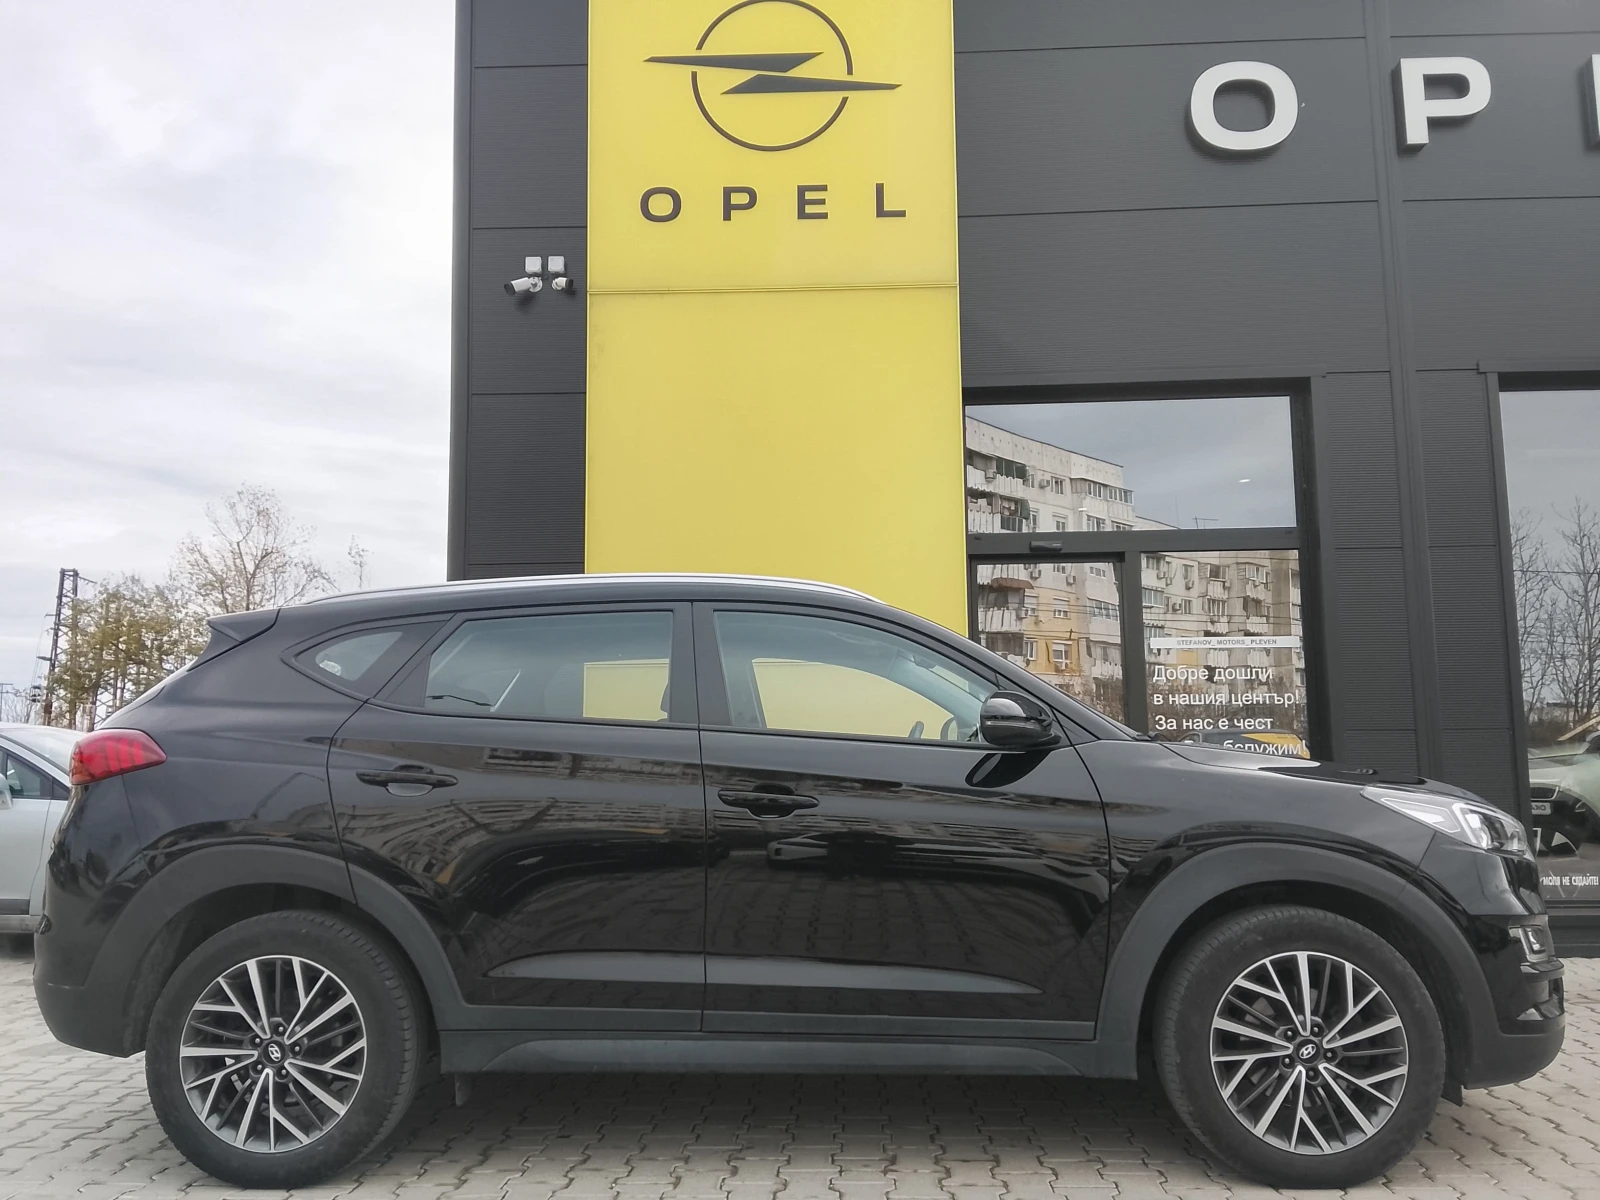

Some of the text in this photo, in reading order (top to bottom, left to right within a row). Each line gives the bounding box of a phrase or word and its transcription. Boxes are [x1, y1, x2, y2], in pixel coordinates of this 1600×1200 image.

[1191, 54, 1600, 150] OP
[640, 182, 906, 222] OPEL
[1153, 665, 1273, 682] Добре дошли
[1153, 689, 1300, 708] в нашия център!
[1155, 715, 1274, 730] За нас е чест
